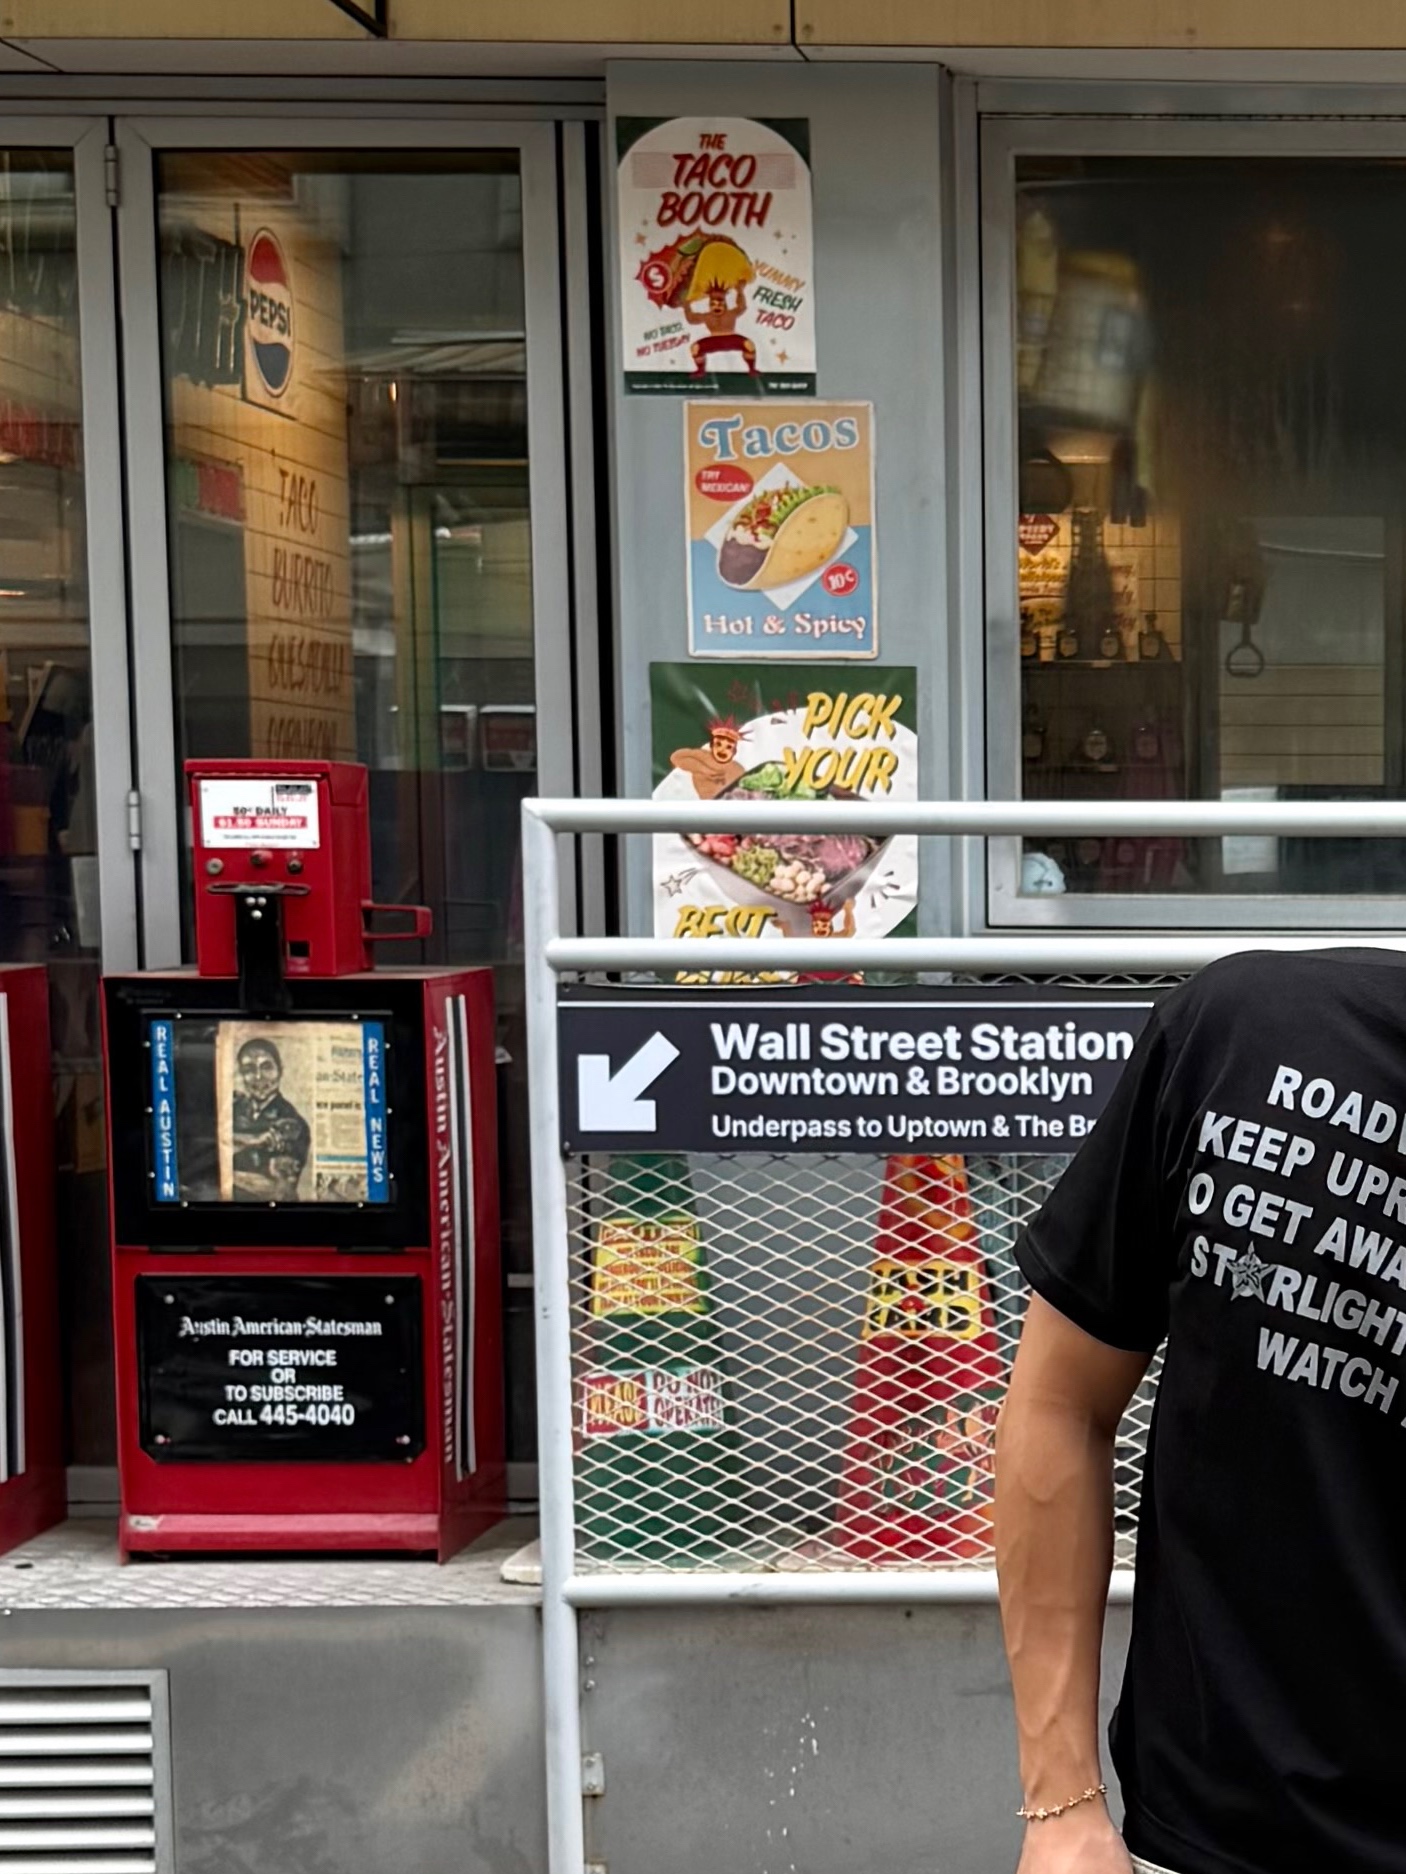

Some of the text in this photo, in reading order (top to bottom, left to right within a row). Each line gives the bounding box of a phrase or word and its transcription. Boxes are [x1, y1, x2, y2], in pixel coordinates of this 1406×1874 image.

[700, 134, 727, 149] THE
[673, 153, 757, 188] TACO
[657, 191, 773, 228] BOOTH
[752, 260, 805, 293] YUMMY
[249, 288, 291, 337] PEPSI
[753, 287, 803, 312] FRESH
[756, 309, 795, 330] TACO
[700, 414, 859, 461] Tacos
[702, 471, 721, 480] TRY
[279, 468, 319, 535] TACO
[704, 613, 866, 640] Hot & Spicy
[802, 692, 902, 741] PICK
[782, 746, 899, 795] YOUR
[710, 1022, 1134, 1060] Wall Street Station
[433, 1025, 448, 1134] Austin
[711, 1066, 1092, 1102] Downtown & Brooklyn
[156, 1026, 174, 1197] REAL AUSTIN
[367, 1038, 385, 1183] REAL NEWS
[712, 1115, 852, 1142] Underpass
[857, 1117, 882, 1137] to
[888, 1115, 987, 1142] Uptown
[991, 1115, 1010, 1137] &
[1015, 1115, 1064, 1137] The
[1198, 1111, 1316, 1178] KEEP
[1222, 1184, 1314, 1245] GET
[178, 1316, 230, 1338] Austin
[228, 1350, 337, 1366] FOR SERVICE
[270, 1367, 296, 1384] OR
[1257, 1327, 1400, 1414] WATCH
[225, 1385, 344, 1401] TO SUBSCRIBE
[212, 1403, 355, 1425] CALL 445-4040
